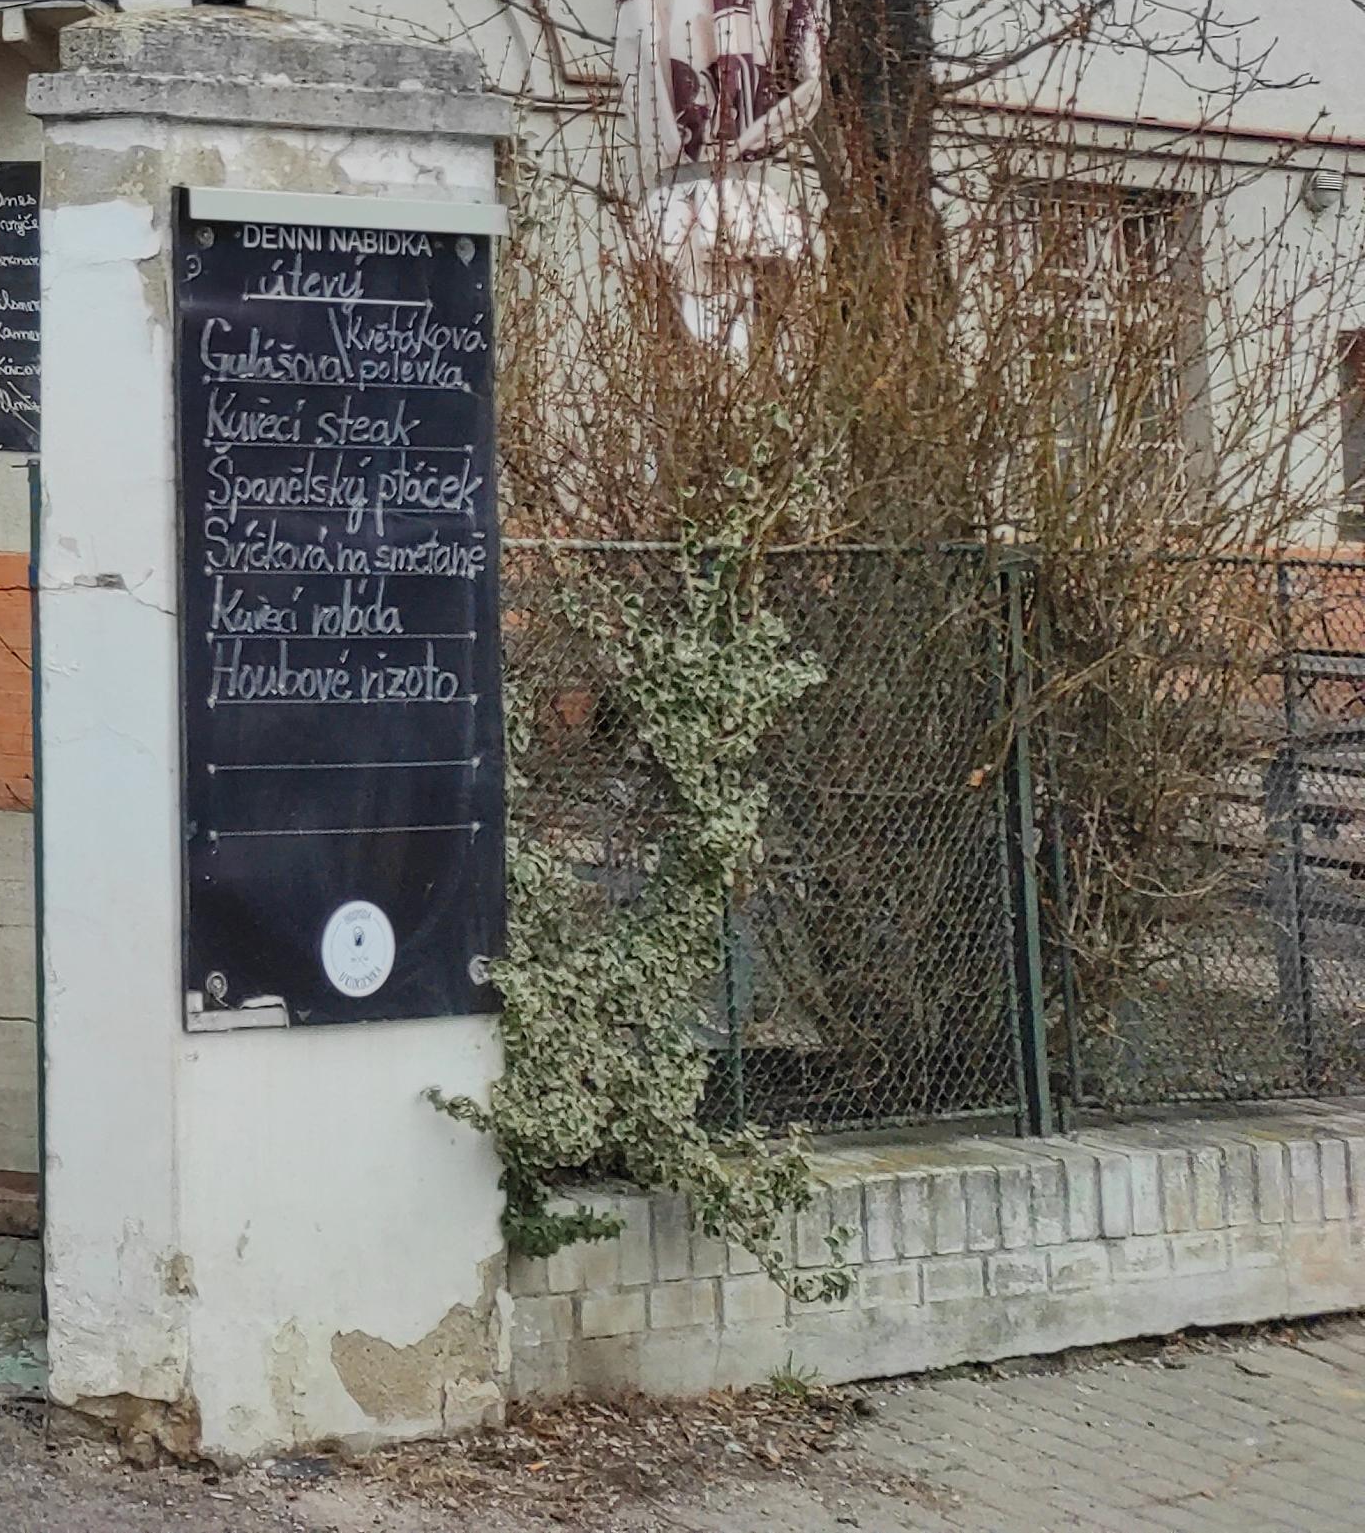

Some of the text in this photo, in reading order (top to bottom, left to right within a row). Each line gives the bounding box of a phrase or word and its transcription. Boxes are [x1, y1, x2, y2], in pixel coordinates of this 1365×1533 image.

[315, 394, 423, 447] steak
[336, 541, 372, 576] na
[360, 640, 460, 704] rizoto
